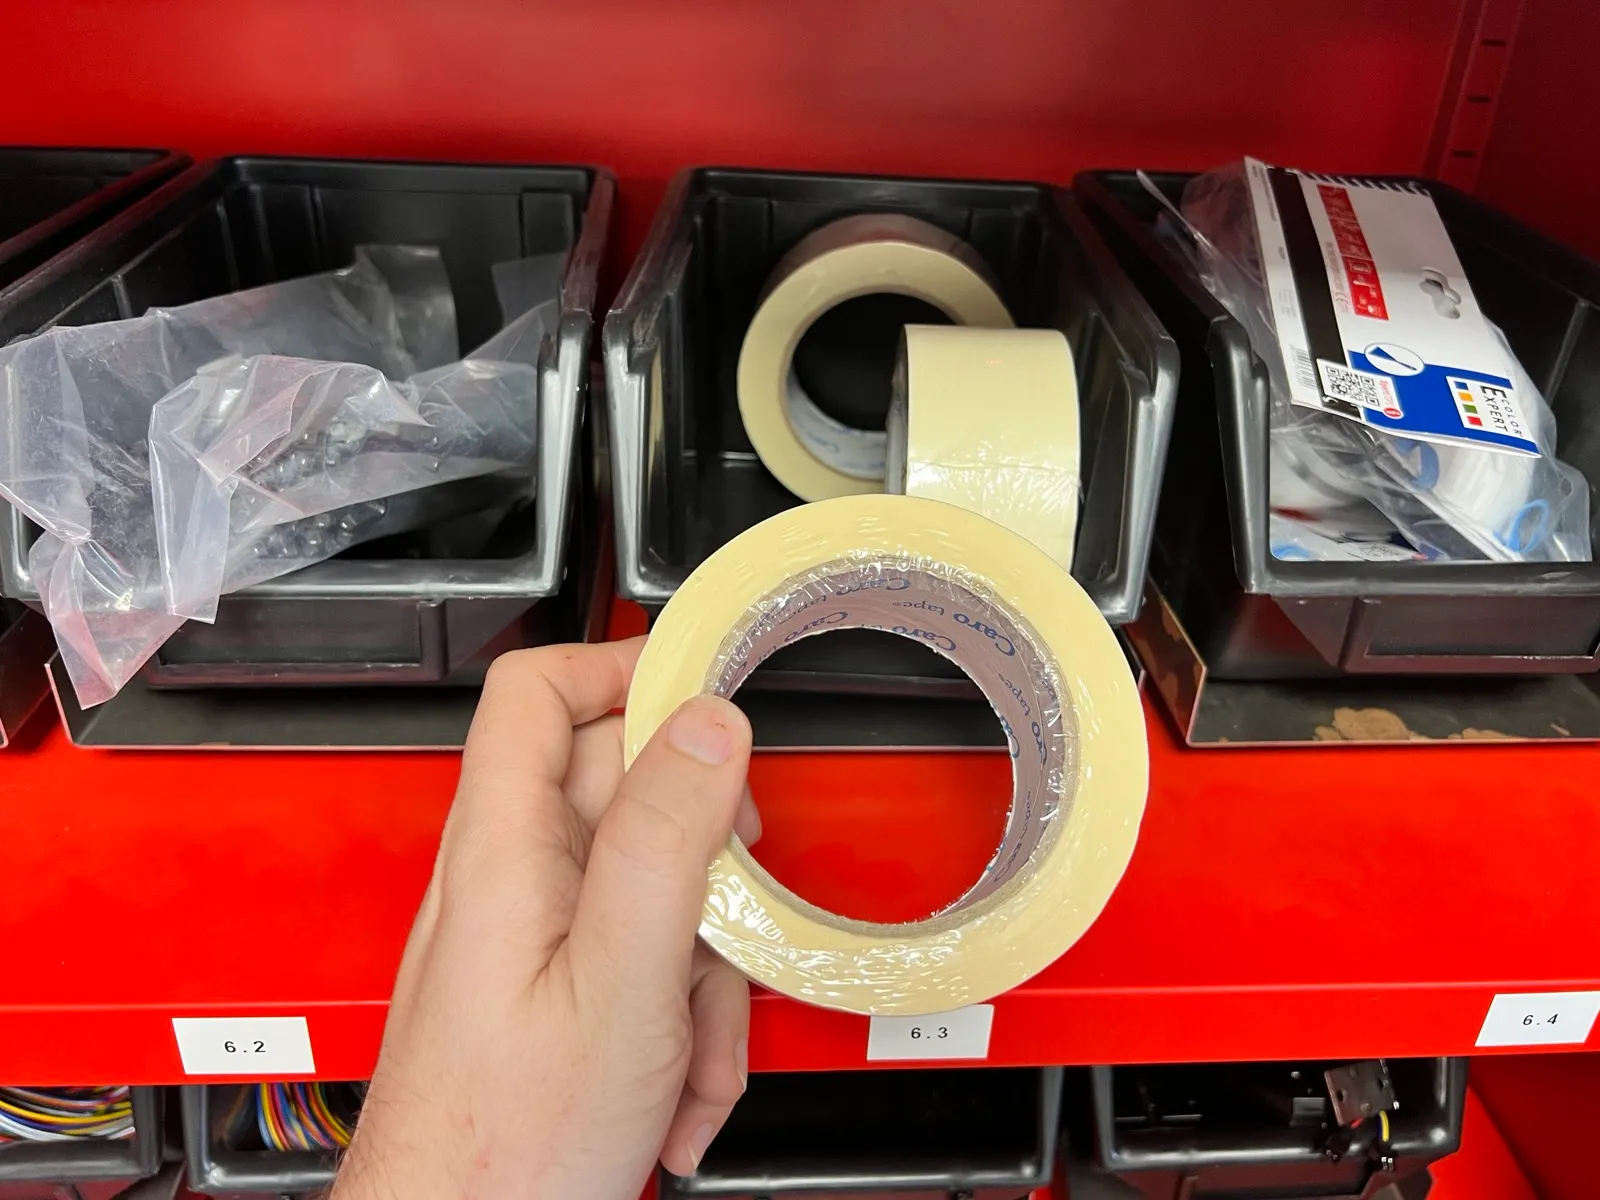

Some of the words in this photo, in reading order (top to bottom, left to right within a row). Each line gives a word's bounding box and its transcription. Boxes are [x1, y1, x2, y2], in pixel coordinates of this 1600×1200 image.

[784, 611, 849, 643] Caro
[953, 612, 1016, 657] Caro
[890, 625, 957, 653] Caro
[1523, 1013, 1559, 1026] 6.4
[911, 1026, 949, 1040] 6.3
[224, 1040, 266, 1054] 6.2
